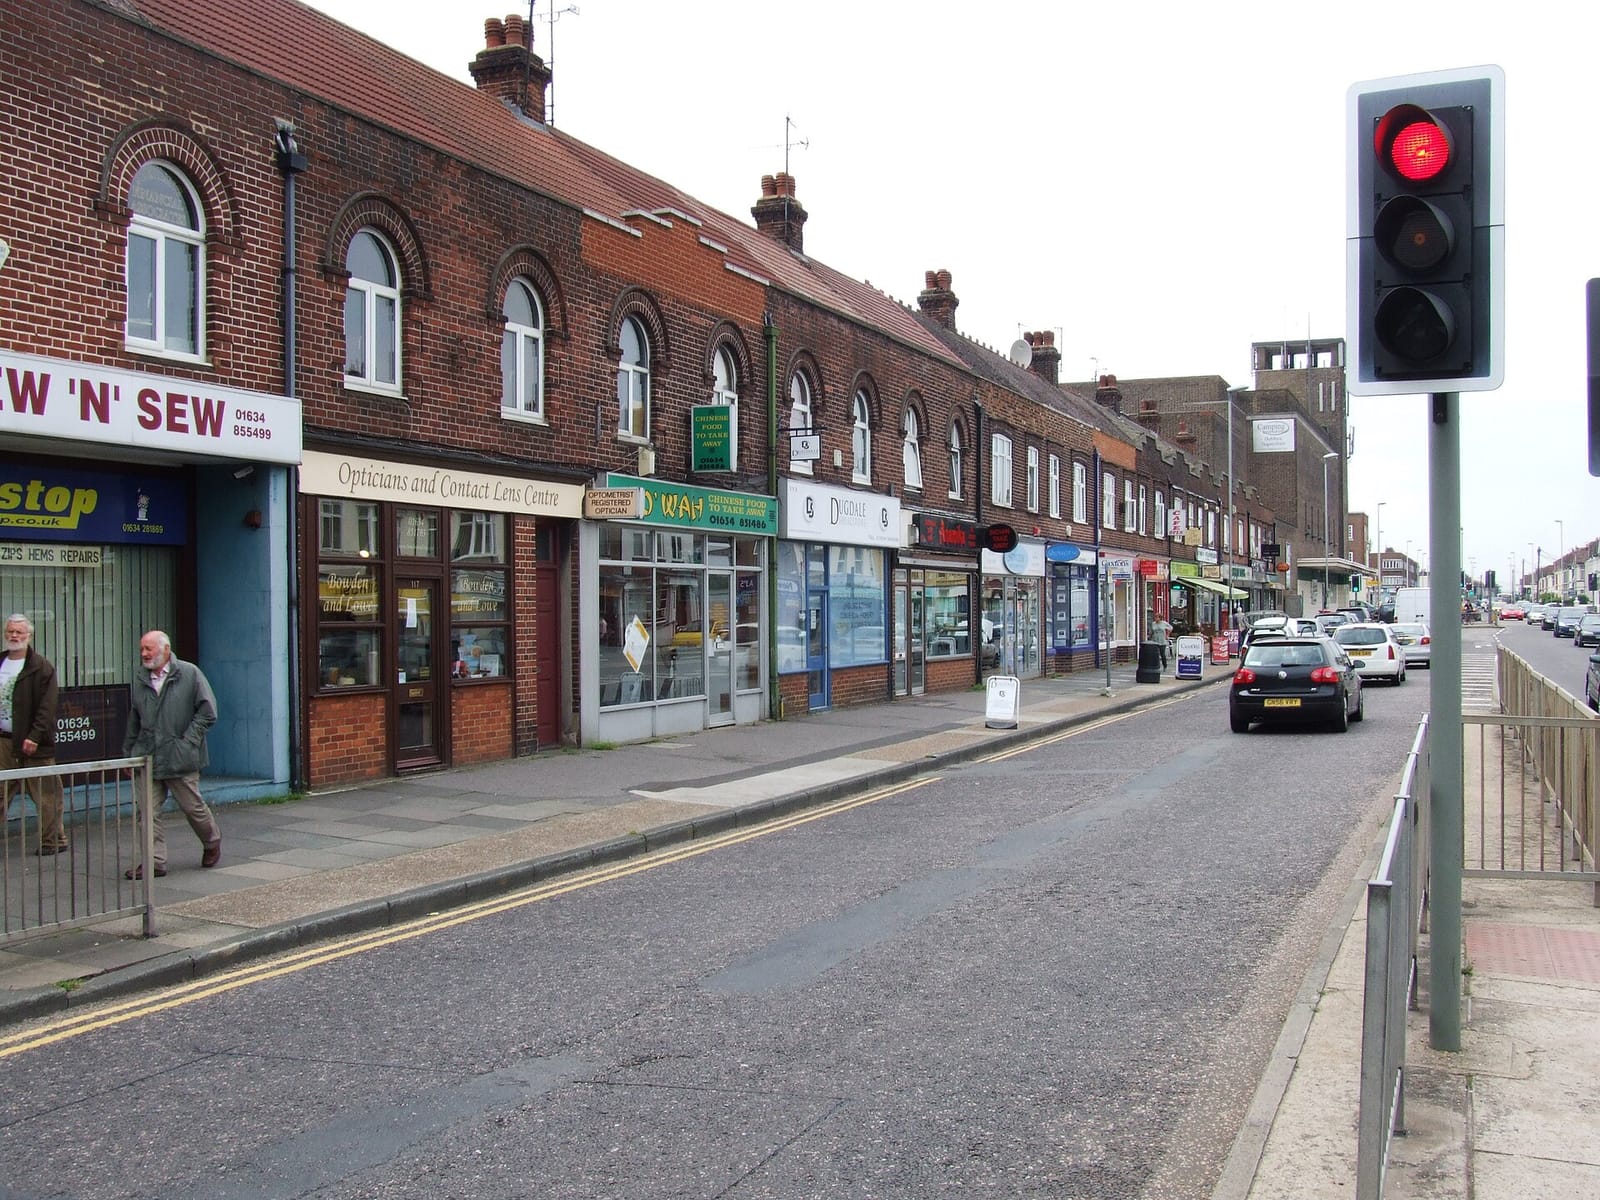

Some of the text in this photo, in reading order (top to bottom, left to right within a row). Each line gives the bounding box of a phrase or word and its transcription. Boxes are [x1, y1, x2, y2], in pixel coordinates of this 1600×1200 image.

[0, 367, 51, 416] W
[137, 388, 226, 438] SEW
[235, 408, 265, 424] 01634
[233, 424, 272, 440] 855499
[338, 461, 560, 508] Opticians and Contact Lens Centre
[588, 491, 634, 499] OPTOMETRIST
[591, 499, 631, 507] REGISTERED
[708, 494, 767, 509] CHINESE FOOD
[595, 507, 628, 515] OPTICIAN
[661, 490, 704, 521] WAH
[708, 504, 721, 513] TO
[723, 505, 745, 515] TAKE
[746, 508, 766, 517] AWAY
[830, 497, 867, 525] DUGDALE
[122, 523, 141, 533] 01634
[709, 515, 767, 530] 01634 851486
[1, 546, 100, 564] ZIPS HEMS REPAIRS
[327, 572, 369, 590] Bowden
[323, 594, 373, 613] and Lowe
[57, 716, 90, 730] 01634
